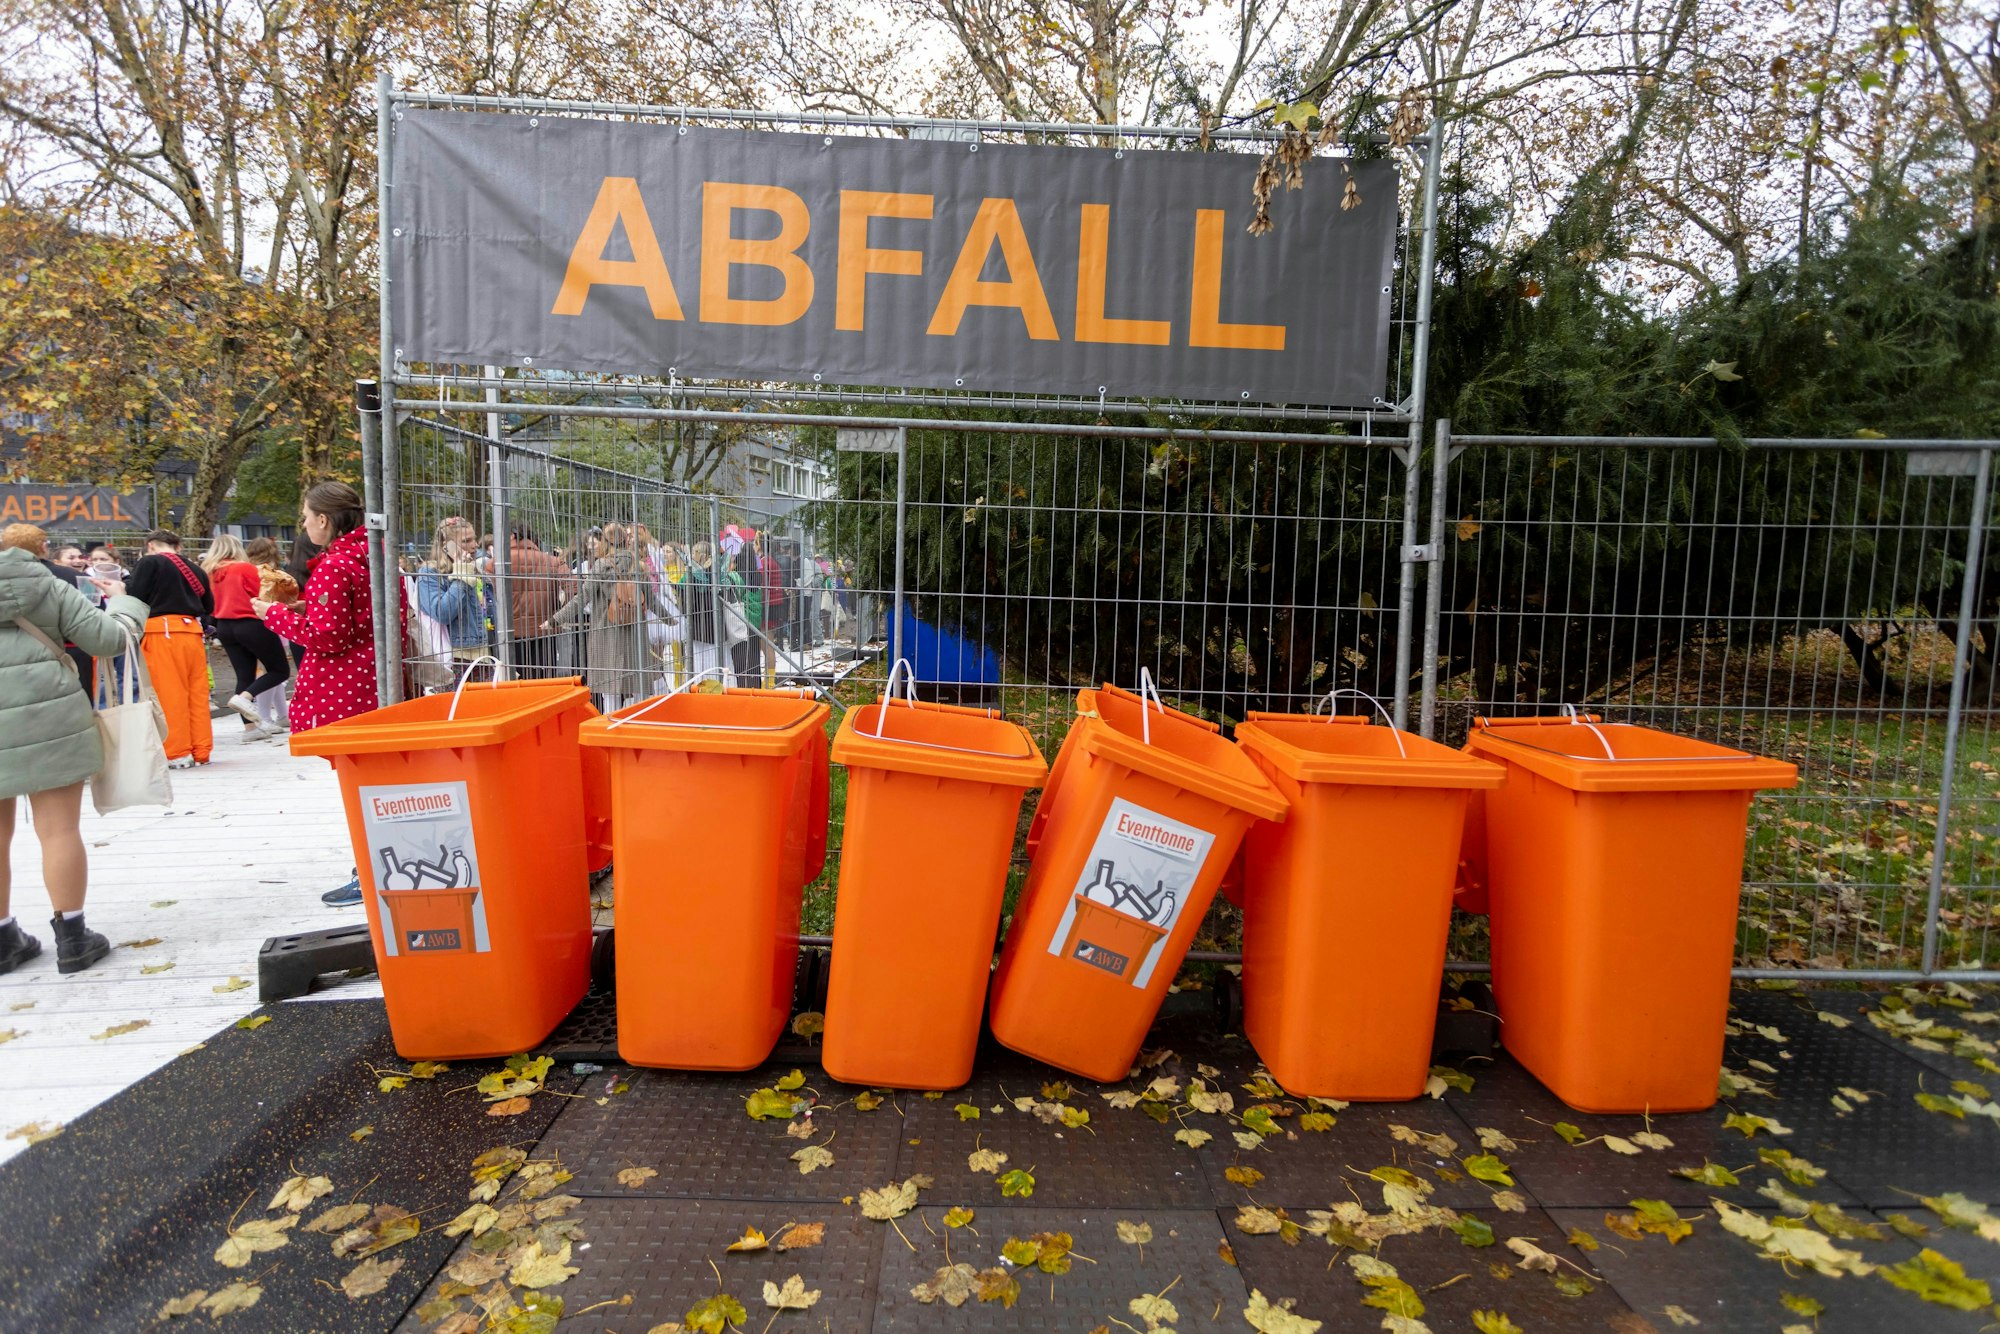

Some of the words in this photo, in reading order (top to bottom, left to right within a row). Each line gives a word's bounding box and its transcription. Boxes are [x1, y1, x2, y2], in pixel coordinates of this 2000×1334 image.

[551, 176, 1286, 350] ABFALL
[0, 494, 132, 521] ABFALL
[373, 793, 452, 817] Eventtonne
[1117, 813, 1195, 852] Eventtonne
[427, 932, 457, 947] AWB
[1092, 950, 1124, 972] AWB
